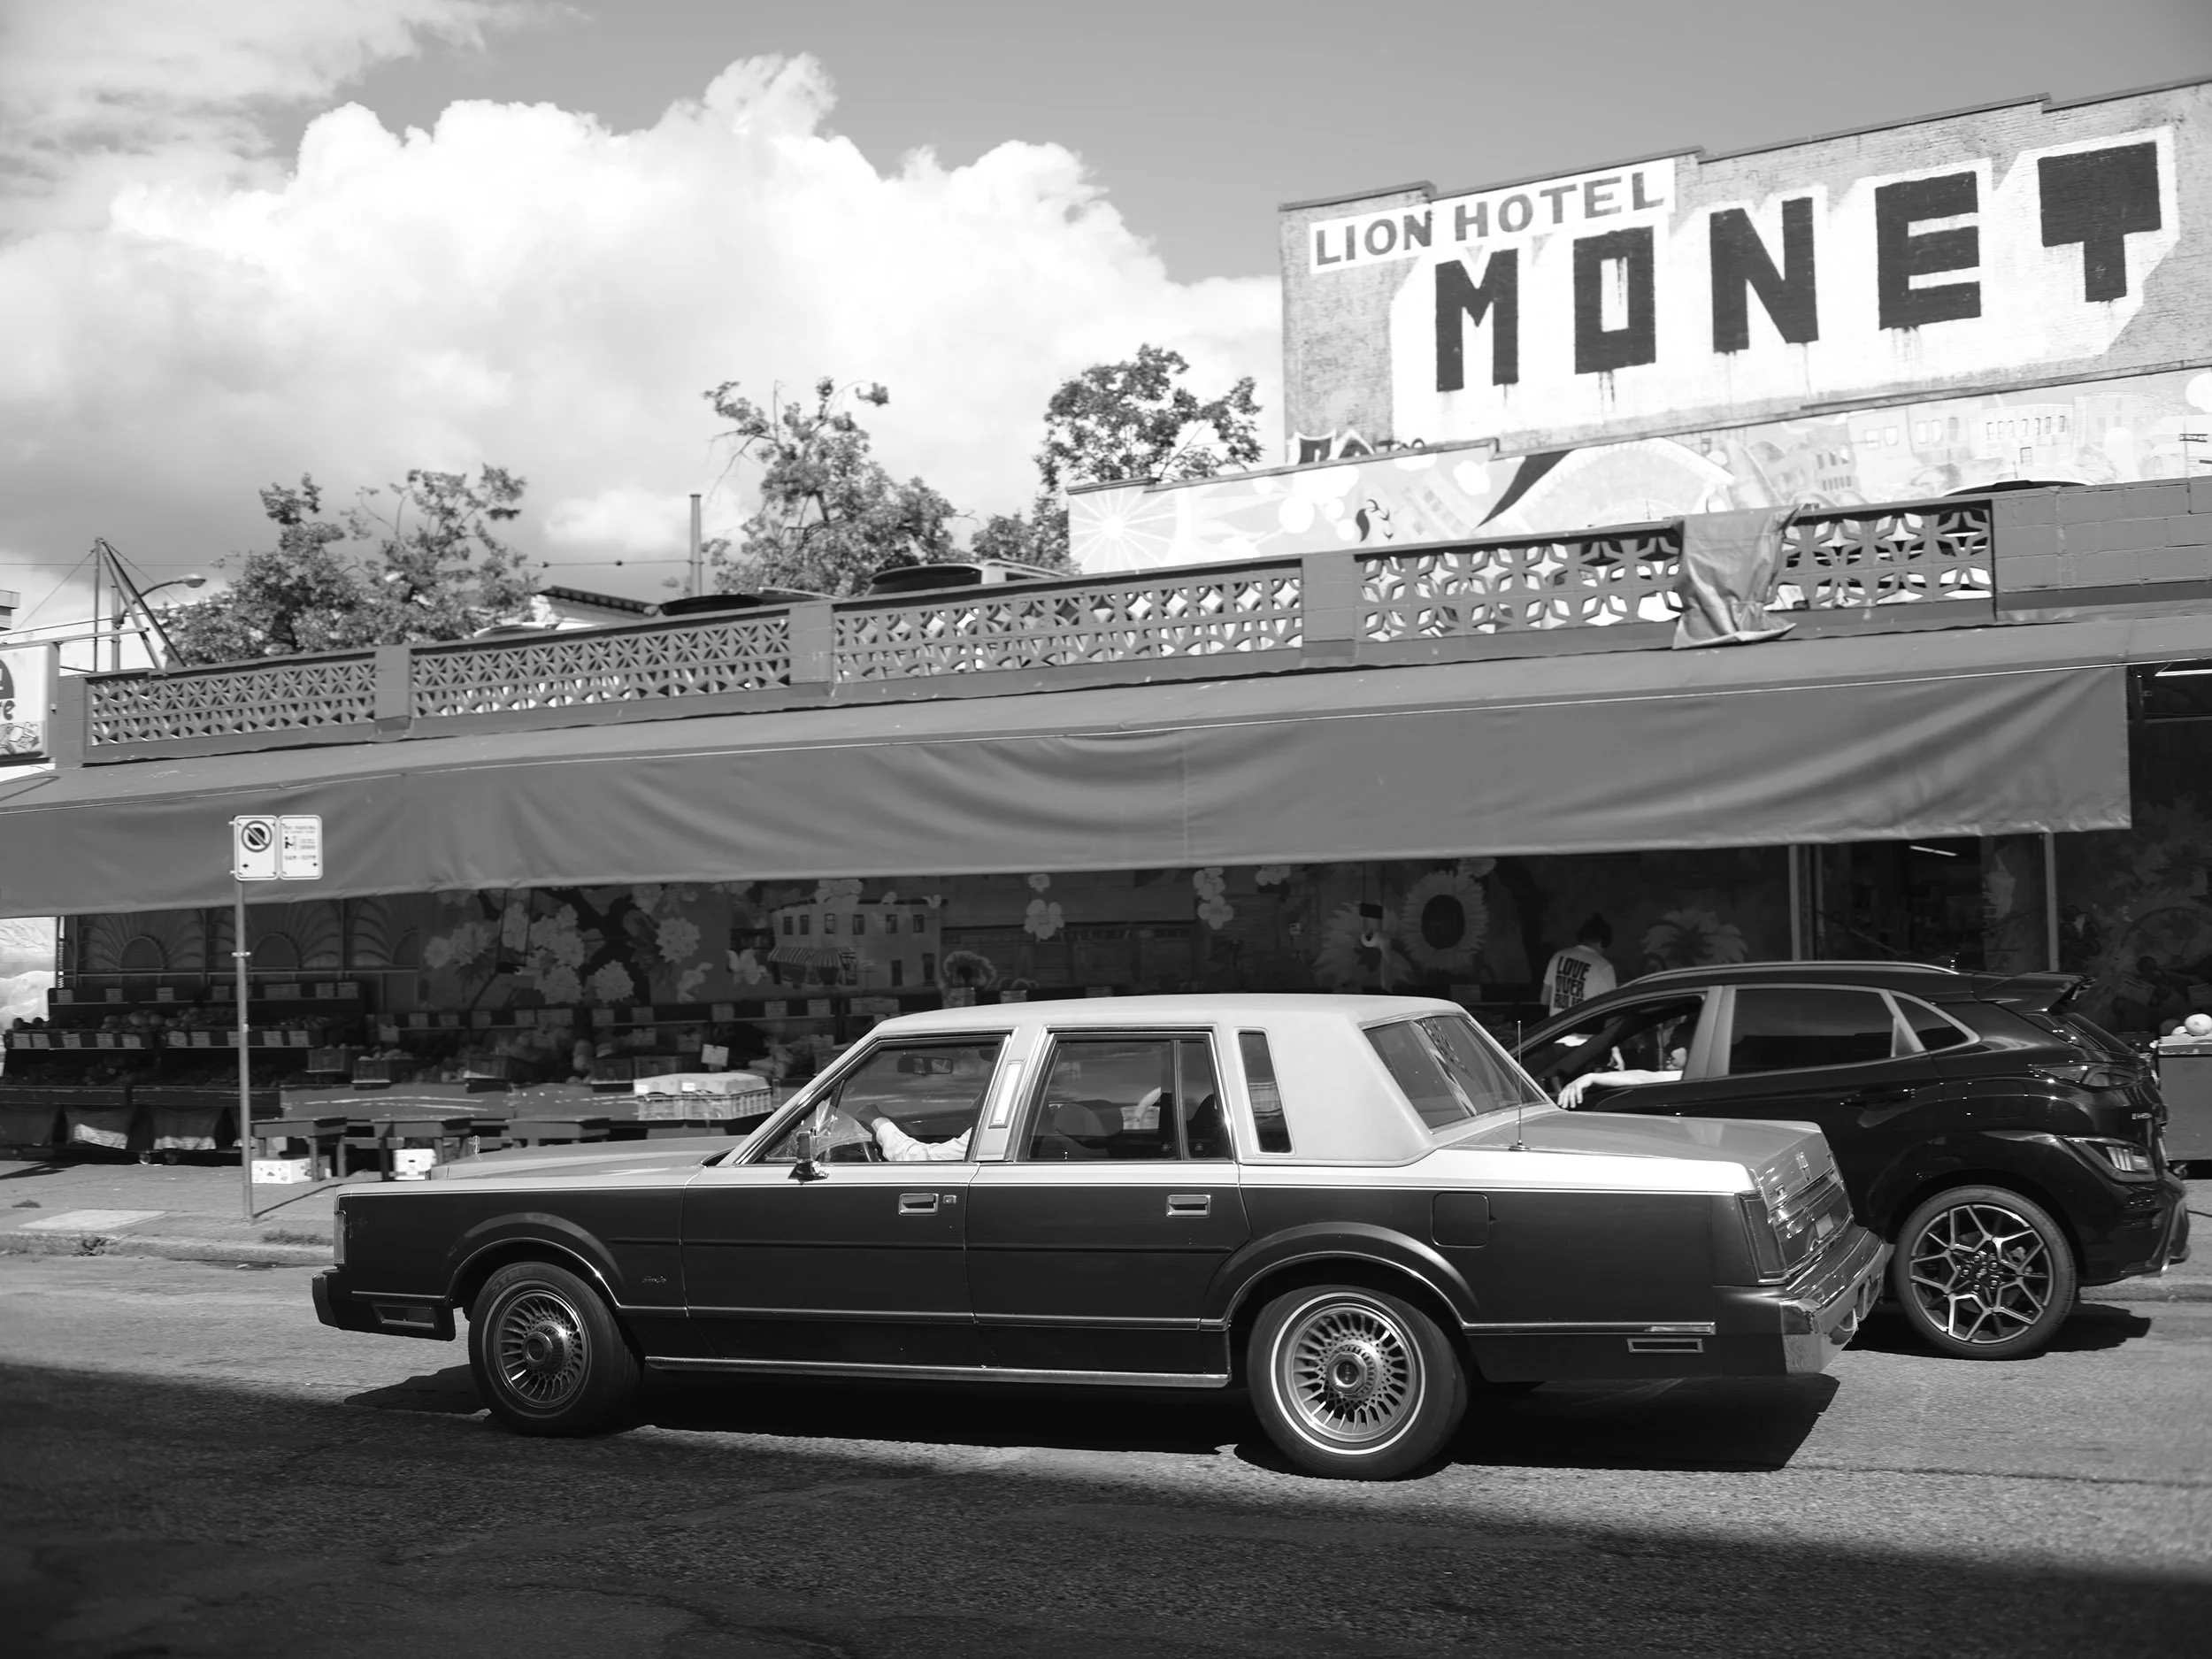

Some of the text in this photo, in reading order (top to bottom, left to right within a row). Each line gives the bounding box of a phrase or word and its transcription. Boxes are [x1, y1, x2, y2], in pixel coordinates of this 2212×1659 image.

[1316, 172, 1664, 266] LION HOTEL
[1434, 141, 2162, 393] MONET
[1555, 975, 1586, 999] OVER
[1556, 956, 1592, 981] LOVE
